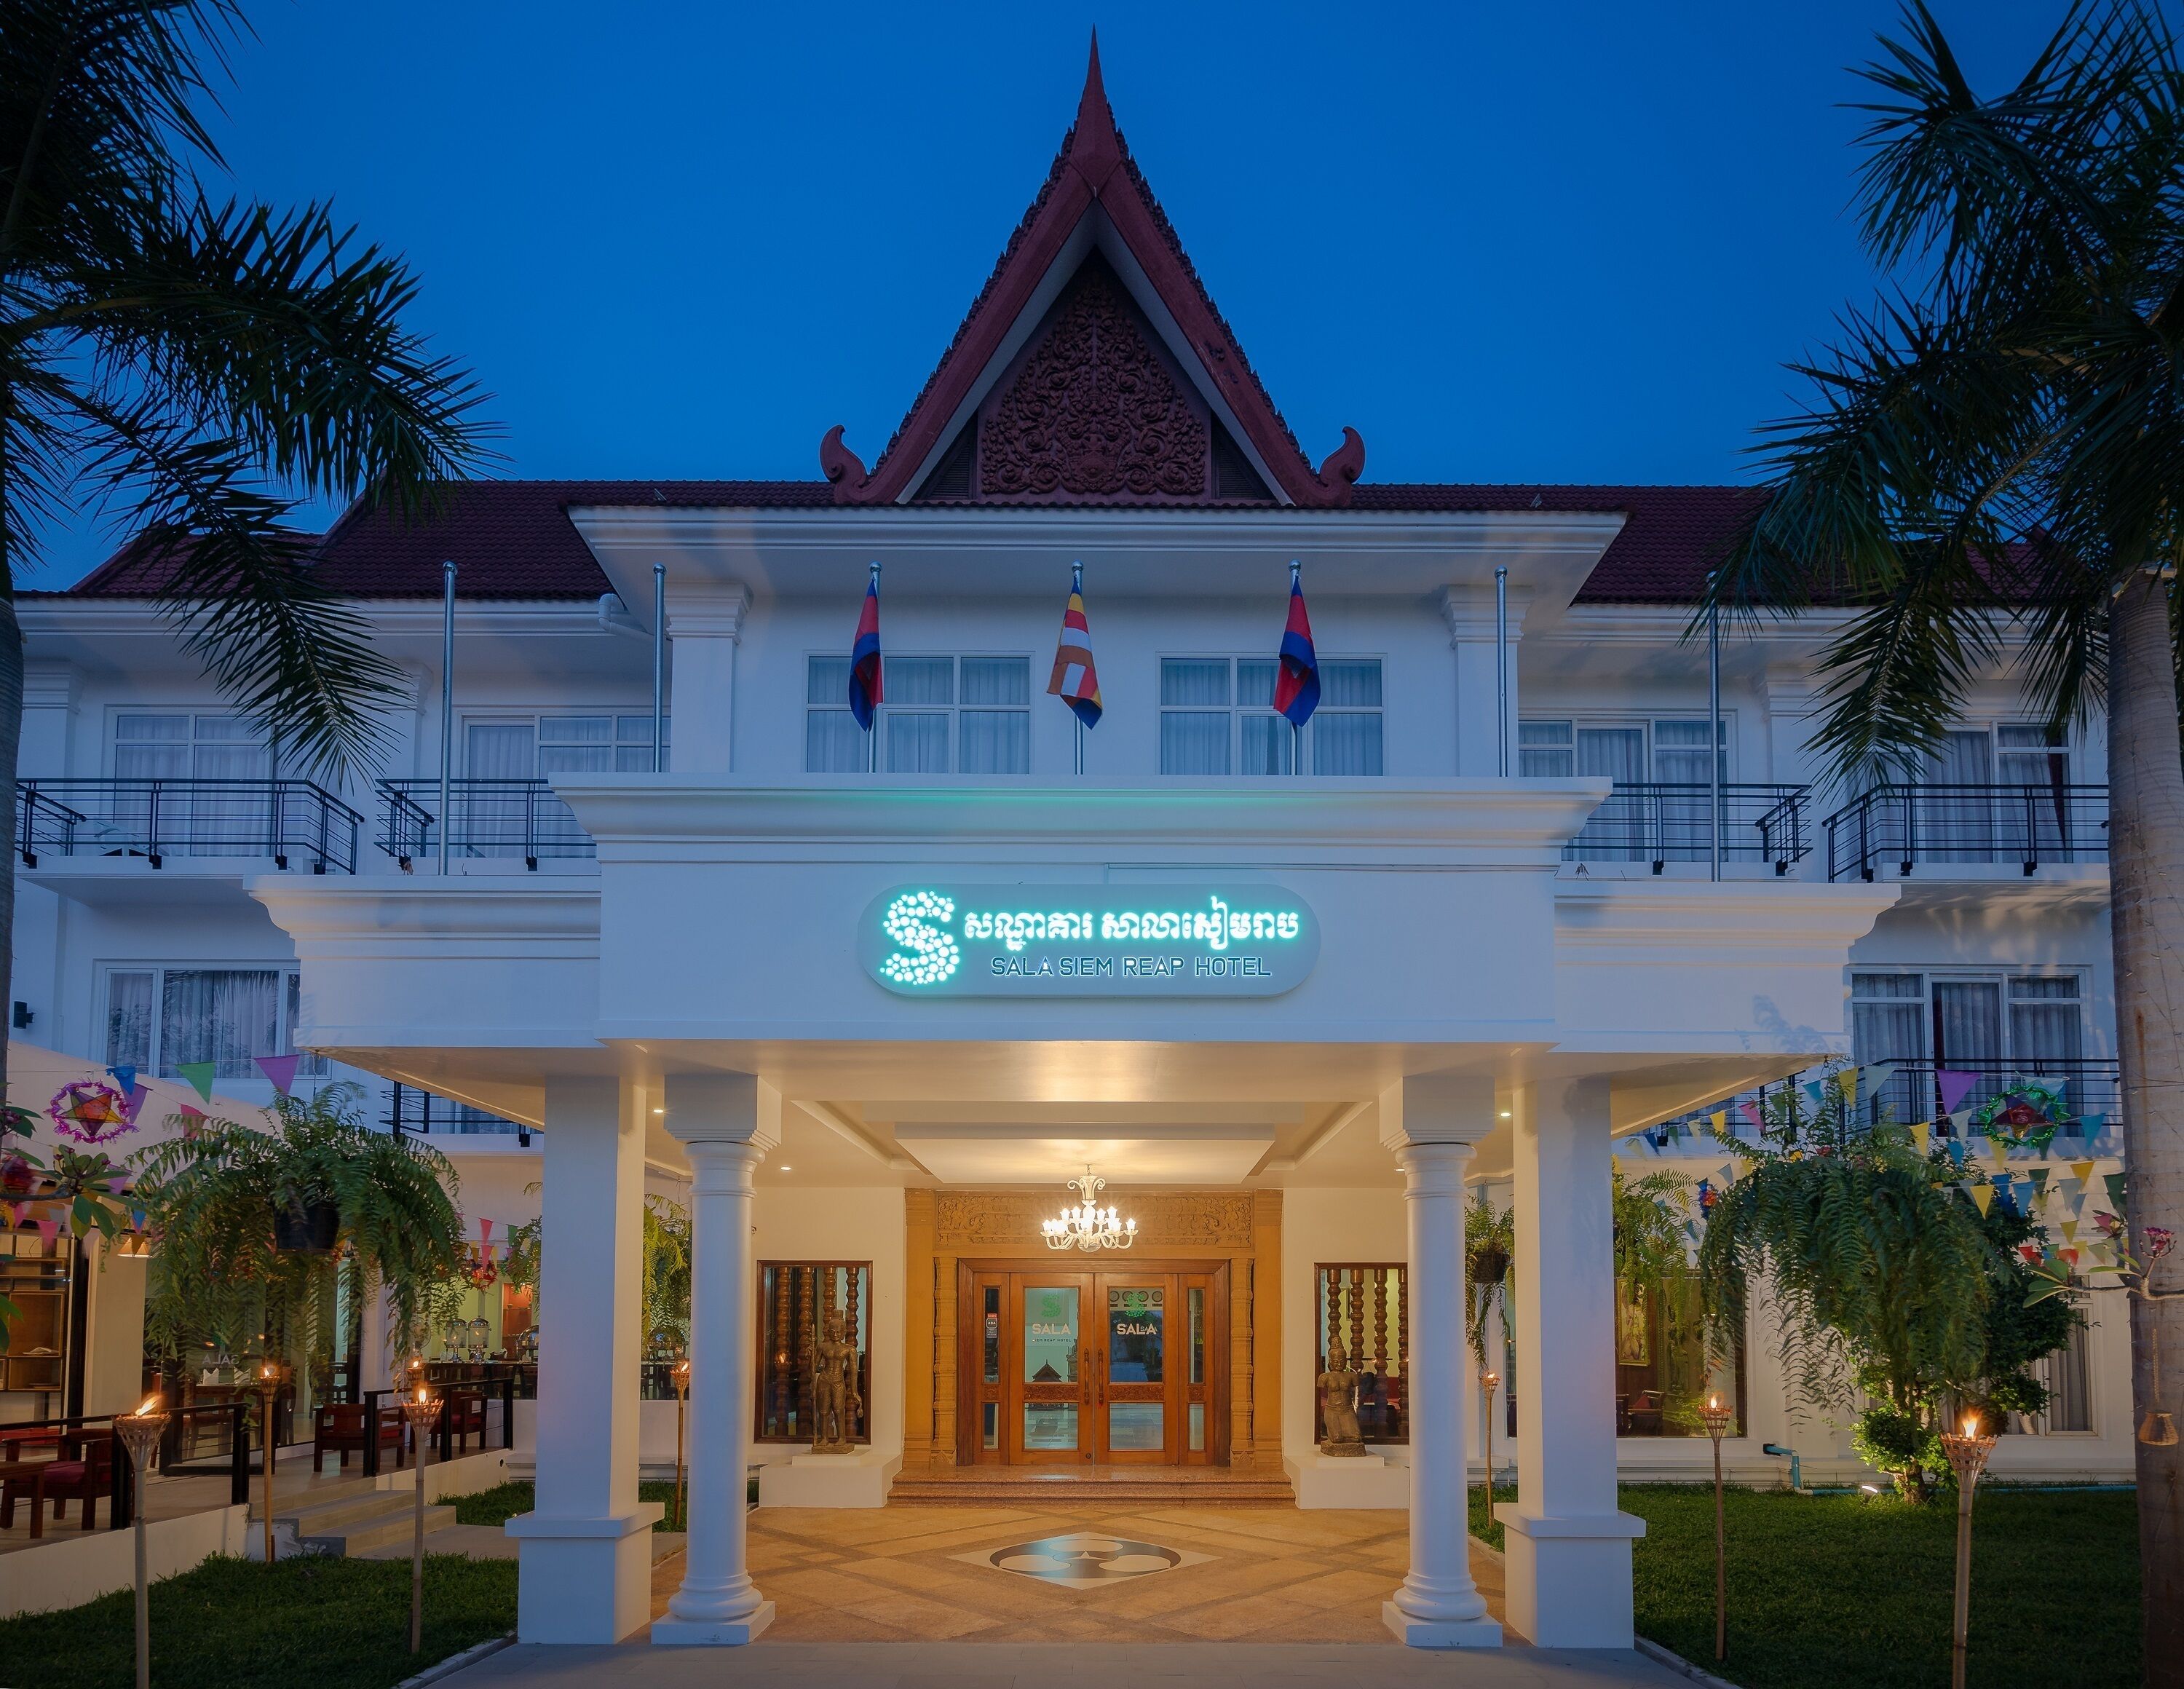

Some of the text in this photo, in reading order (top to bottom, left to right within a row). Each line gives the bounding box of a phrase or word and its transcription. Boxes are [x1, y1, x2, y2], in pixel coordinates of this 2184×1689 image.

[1101, 895, 1299, 951] សាលាសៀមរាប
[991, 957, 1273, 976] SALA SIEM REAP HOTEL
[1032, 1323, 1072, 1334] SALA
[1117, 1323, 1157, 1335] SALA
